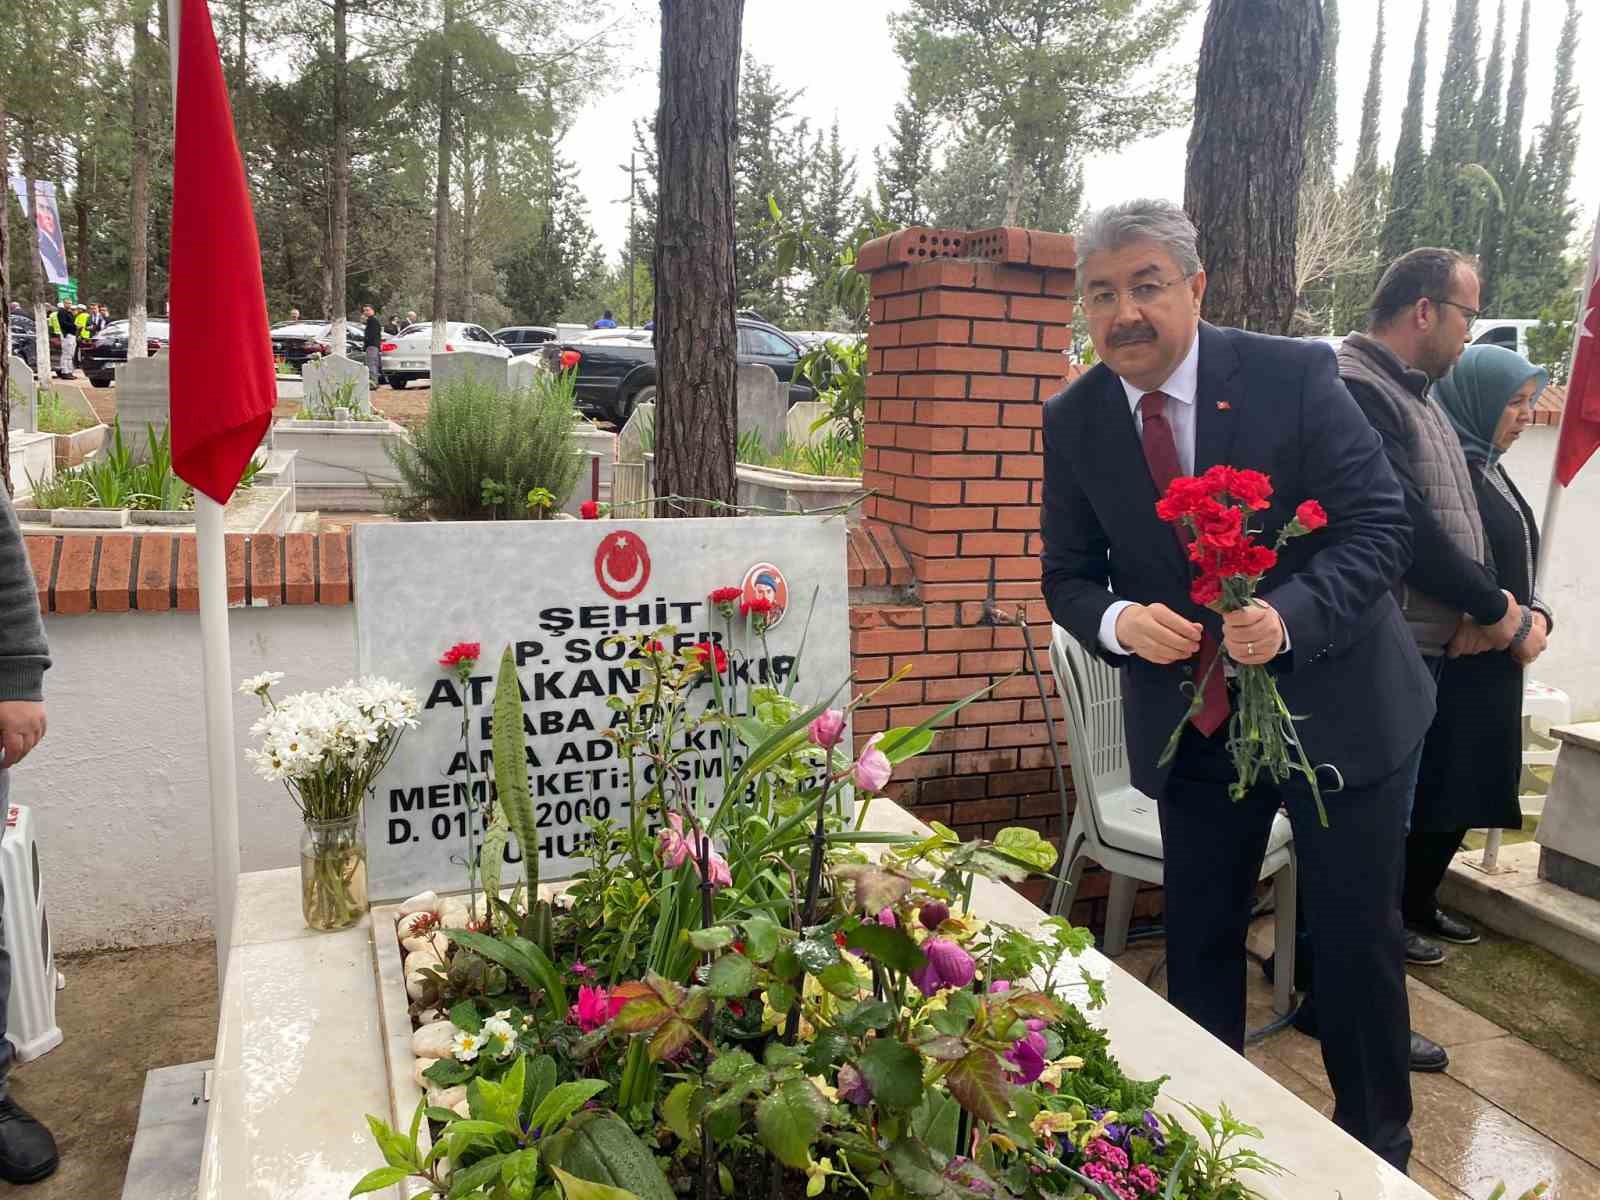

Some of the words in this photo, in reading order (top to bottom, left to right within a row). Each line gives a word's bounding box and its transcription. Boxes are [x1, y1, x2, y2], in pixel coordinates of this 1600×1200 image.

[538, 597, 702, 637] ŞEHİT
[516, 640, 550, 667] P.
[564, 630, 724, 664] SÖZER
[424, 667, 641, 709] ATKAN
[388, 817, 420, 845] D.
[432, 796, 611, 840] 01..2000
